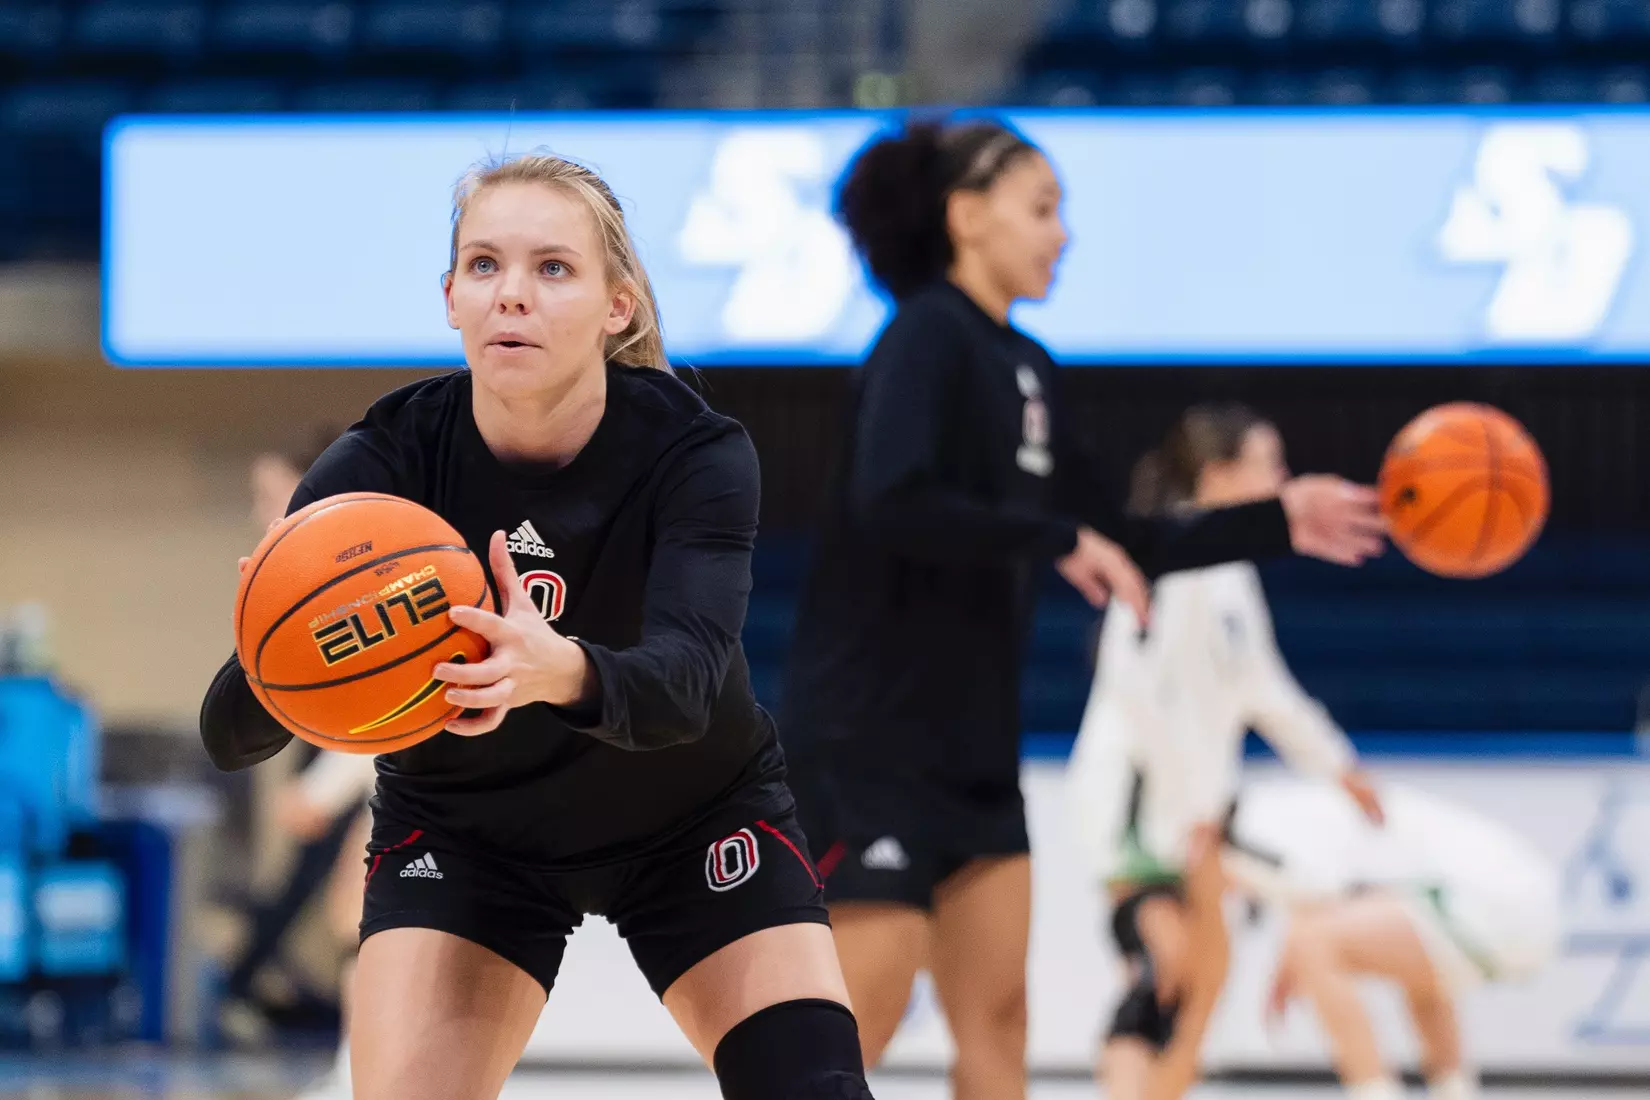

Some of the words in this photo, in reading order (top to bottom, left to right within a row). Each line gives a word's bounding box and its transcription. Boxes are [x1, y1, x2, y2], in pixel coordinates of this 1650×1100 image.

[505, 539, 556, 558] adidas
[308, 564, 437, 629] CHAMPIONSHIP
[311, 576, 452, 668] ELITE
[399, 867, 444, 880] adidas
